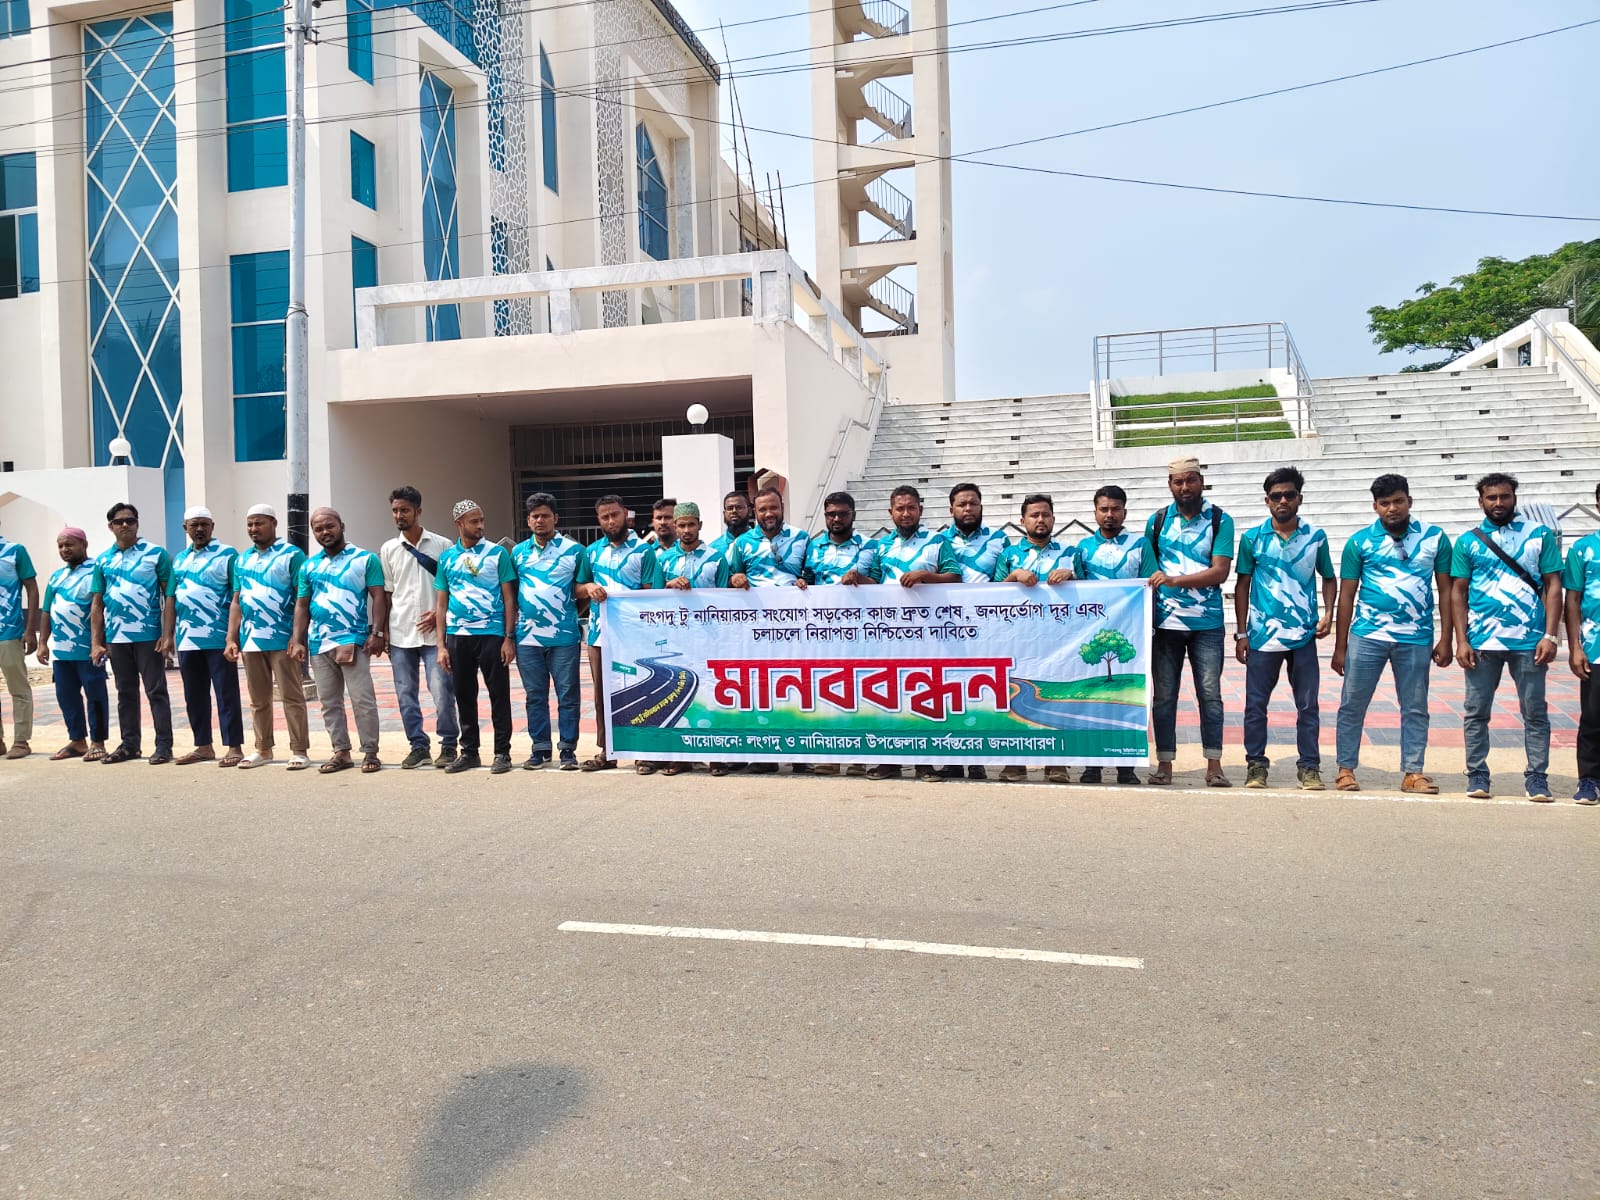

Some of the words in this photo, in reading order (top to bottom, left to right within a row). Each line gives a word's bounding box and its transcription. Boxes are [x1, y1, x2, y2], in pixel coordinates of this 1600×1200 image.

[639, 609, 675, 626] লংগদু
[679, 606, 688, 627] টু
[693, 605, 758, 623] নানিয়ারচর
[762, 608, 808, 623] সংযোগ
[812, 607, 862, 624] সড়কের
[866, 607, 897, 620] কাজ
[901, 606, 930, 622] দ্রুত
[974, 599, 1043, 623] জনদূর্ভোগ
[1048, 603, 1071, 622] দূর
[1075, 603, 1106, 618] এবং
[752, 628, 801, 642] চলাচলে
[805, 623, 859, 640] নিরাপত্তা
[862, 622, 924, 640] নিশ্চিতের
[928, 621, 978, 639] দাবিতে
[706, 657, 1014, 721] মানববন্ধন
[746, 735, 782, 752] লংগদু
[785, 736, 796, 748] ও
[799, 731, 862, 749] নানিয়ারচর
[865, 732, 927, 750] উপজেলার
[931, 732, 984, 751] সর্বস্তরের
[987, 736, 1056, 751] জনসাধারণ
